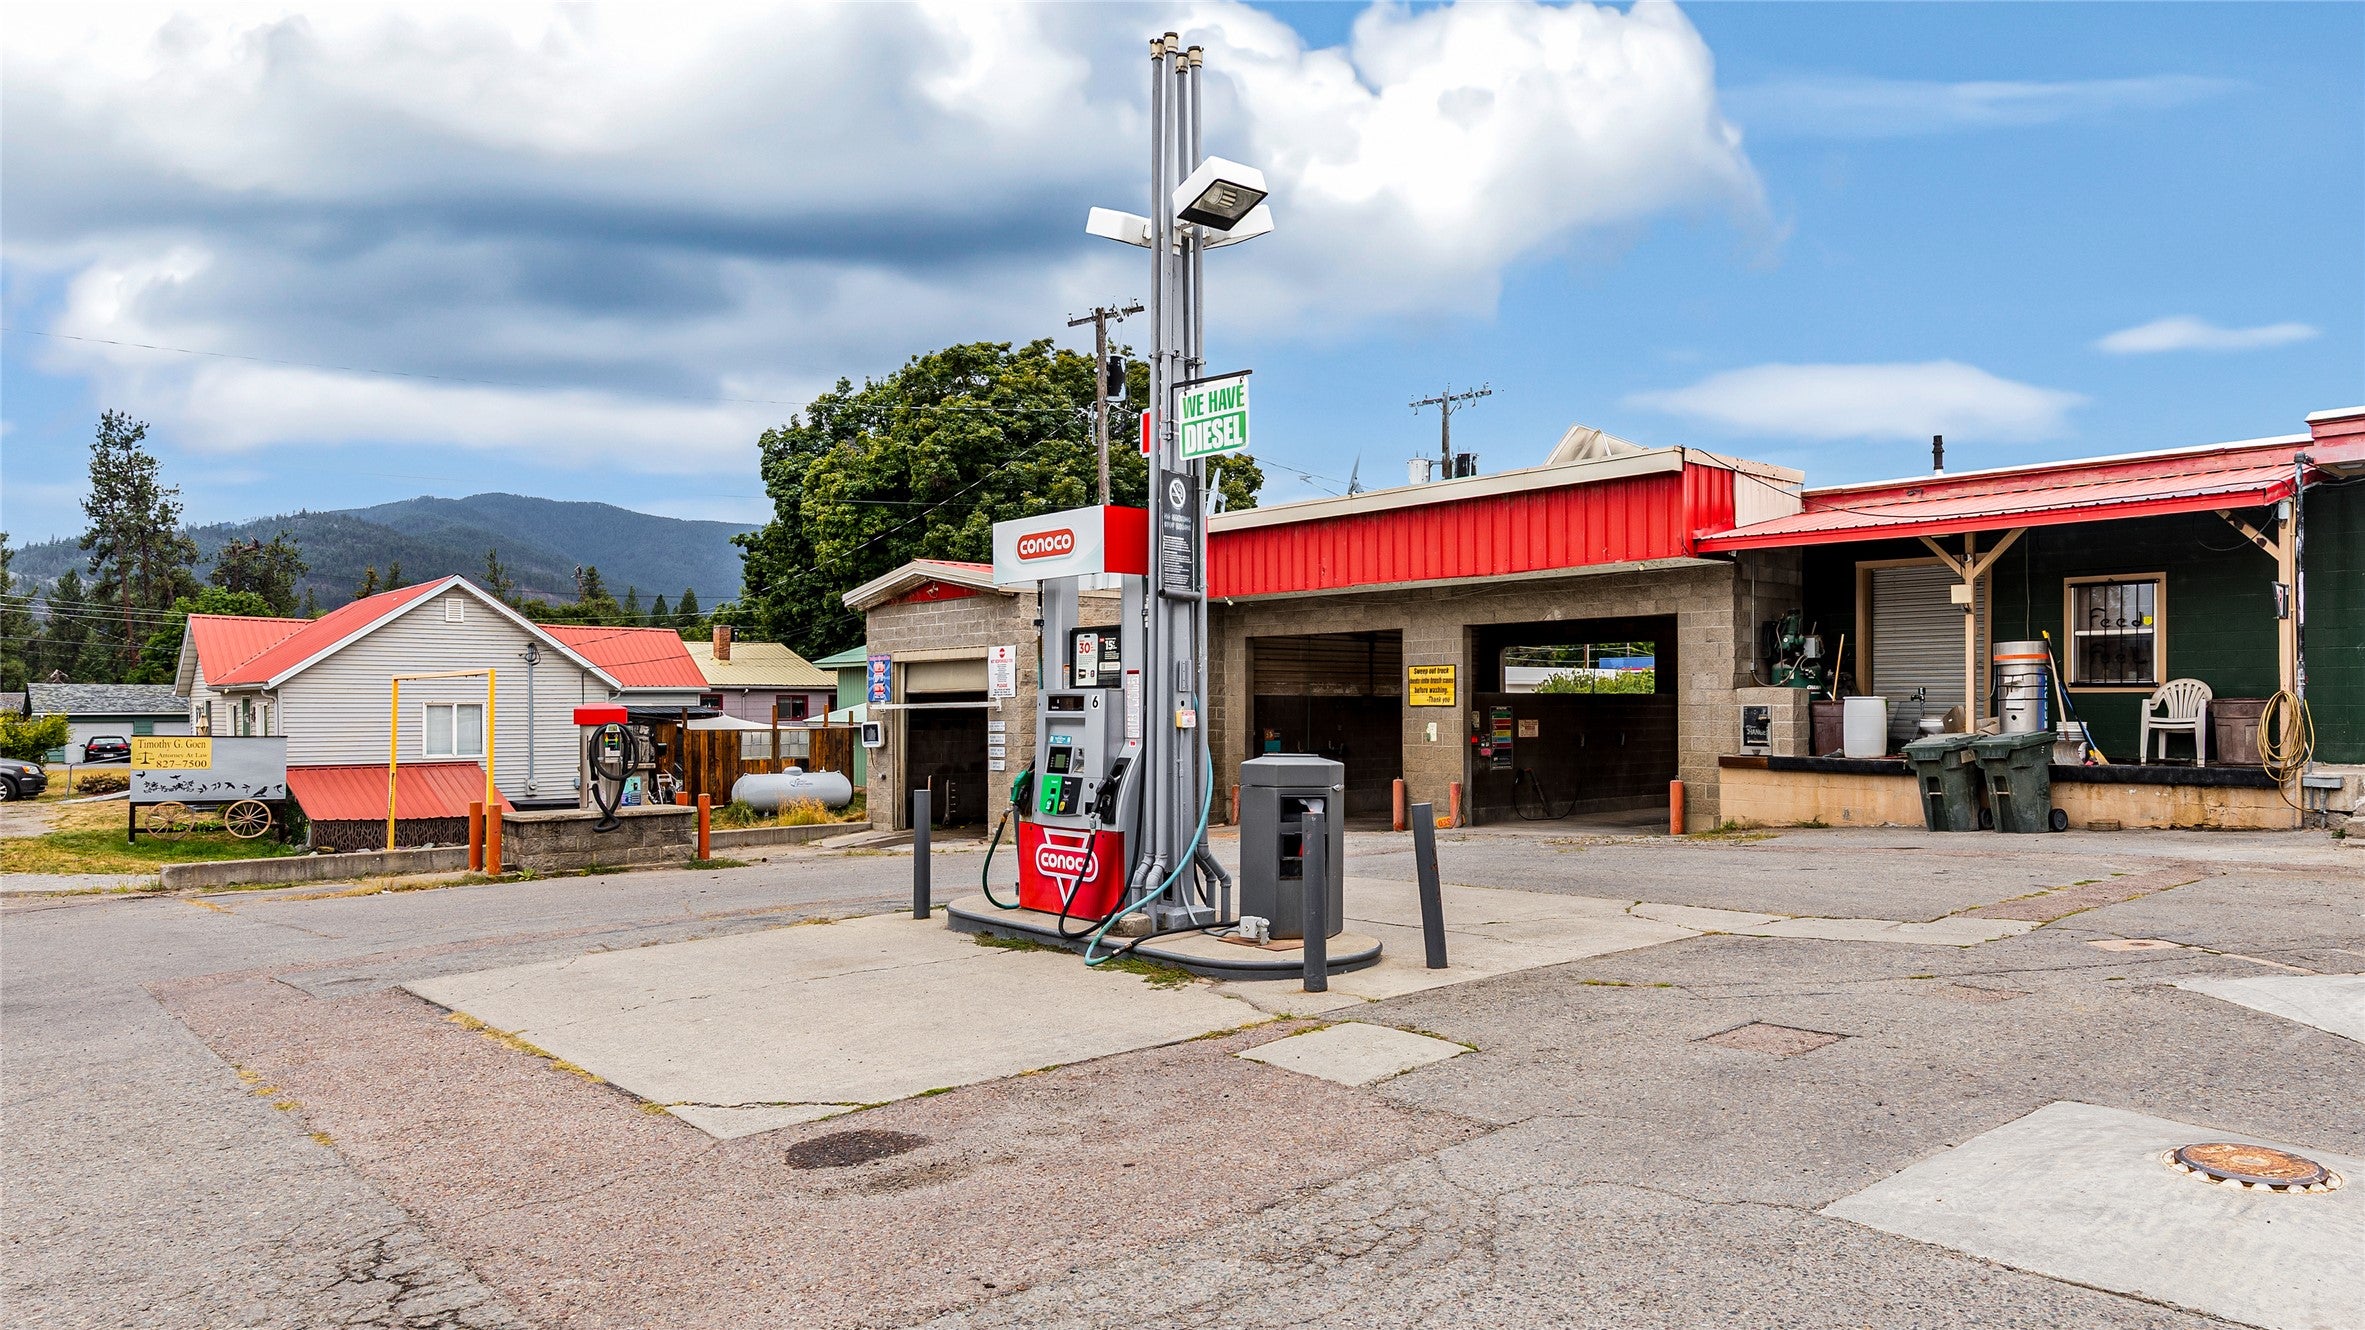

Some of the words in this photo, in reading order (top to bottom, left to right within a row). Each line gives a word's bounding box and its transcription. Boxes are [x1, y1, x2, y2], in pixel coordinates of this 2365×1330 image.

[1182, 393, 1204, 419] WE
[1208, 384, 1245, 413] HAVE
[1184, 414, 1244, 454] DIESEL
[1413, 667, 1428, 675] Sweep
[1092, 695, 1099, 708] 6
[138, 738, 171, 752] Timothy
[173, 739, 184, 749] G.
[156, 759, 207, 769] 827-7500
